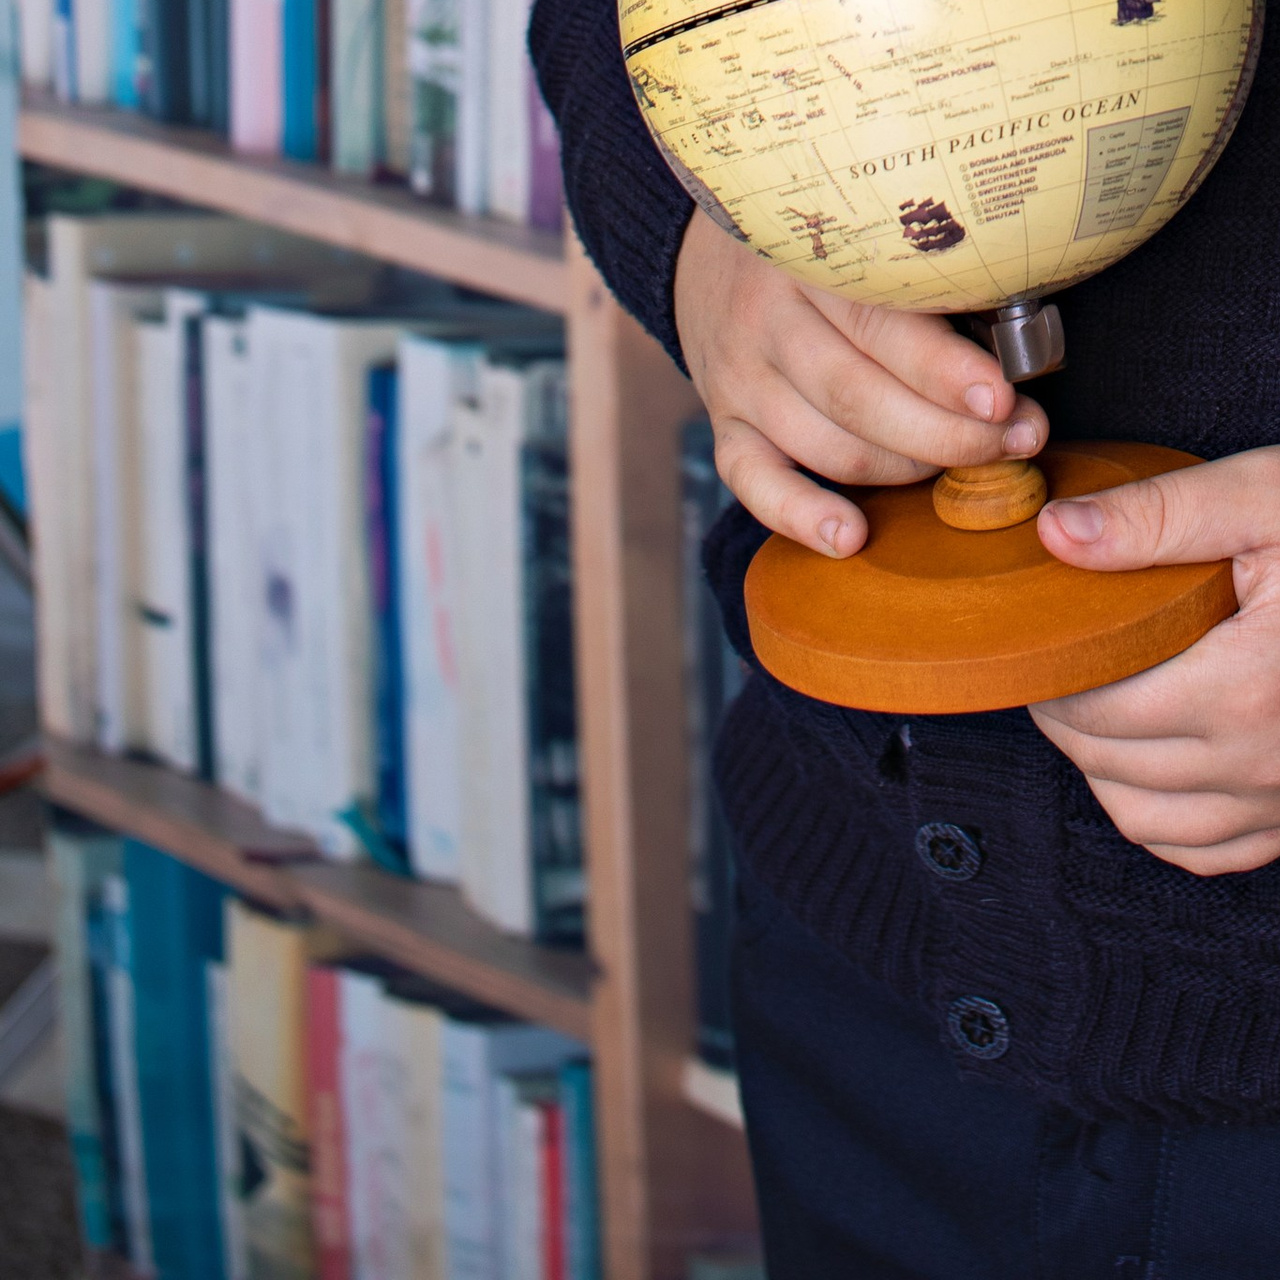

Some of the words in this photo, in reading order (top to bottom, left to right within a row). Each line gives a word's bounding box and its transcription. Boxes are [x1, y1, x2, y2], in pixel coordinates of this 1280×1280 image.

[827, 54, 852, 81] COOK
[916, 73, 950, 86] FRENCH
[951, 60, 996, 77] POLYNESIA
[850, 145, 936, 179] SOUTH
[949, 113, 1050, 154] PACIFIC
[1062, 89, 1141, 122] OCEAN
[969, 155, 999, 168] BOSNIA
[1001, 149, 1017, 160] AND
[1019, 135, 1074, 155] HERZEGOVINA
[973, 164, 1008, 178] ANTIGUA
[1010, 159, 1026, 168] AND
[1028, 148, 1066, 163] BARBUDA
[975, 166, 1037, 188] LIECHTENSTEIN
[978, 176, 1036, 197] SWITZERLAND
[980, 185, 1039, 206] LUXEMBOURG
[983, 199, 1025, 214] SLOVENIA
[986, 209, 1020, 222] BHUTAN
